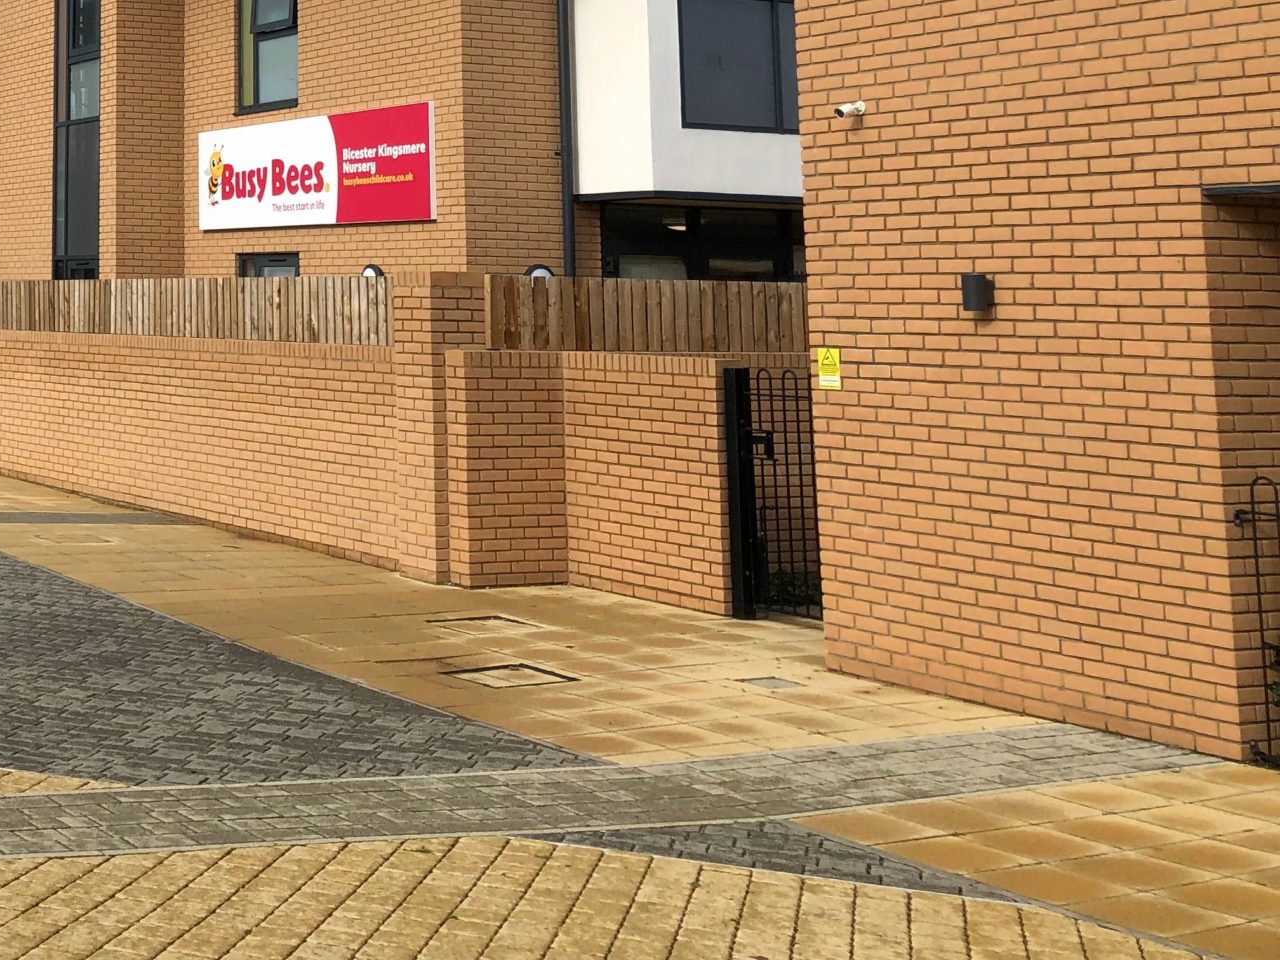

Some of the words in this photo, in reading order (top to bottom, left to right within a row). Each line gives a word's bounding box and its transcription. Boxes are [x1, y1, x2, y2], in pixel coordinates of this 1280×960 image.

[342, 147, 377, 160] Bicester
[378, 142, 426, 159] Kingsmere
[342, 161, 376, 174] Nursery
[221, 163, 268, 203] Busy
[343, 171, 414, 187] busybeeschildcare.co.uk
[272, 203, 282, 212] The
[283, 202, 295, 211] best
[296, 202, 309, 211] start
[310, 202, 315, 210] in
[315, 199, 325, 210] life
